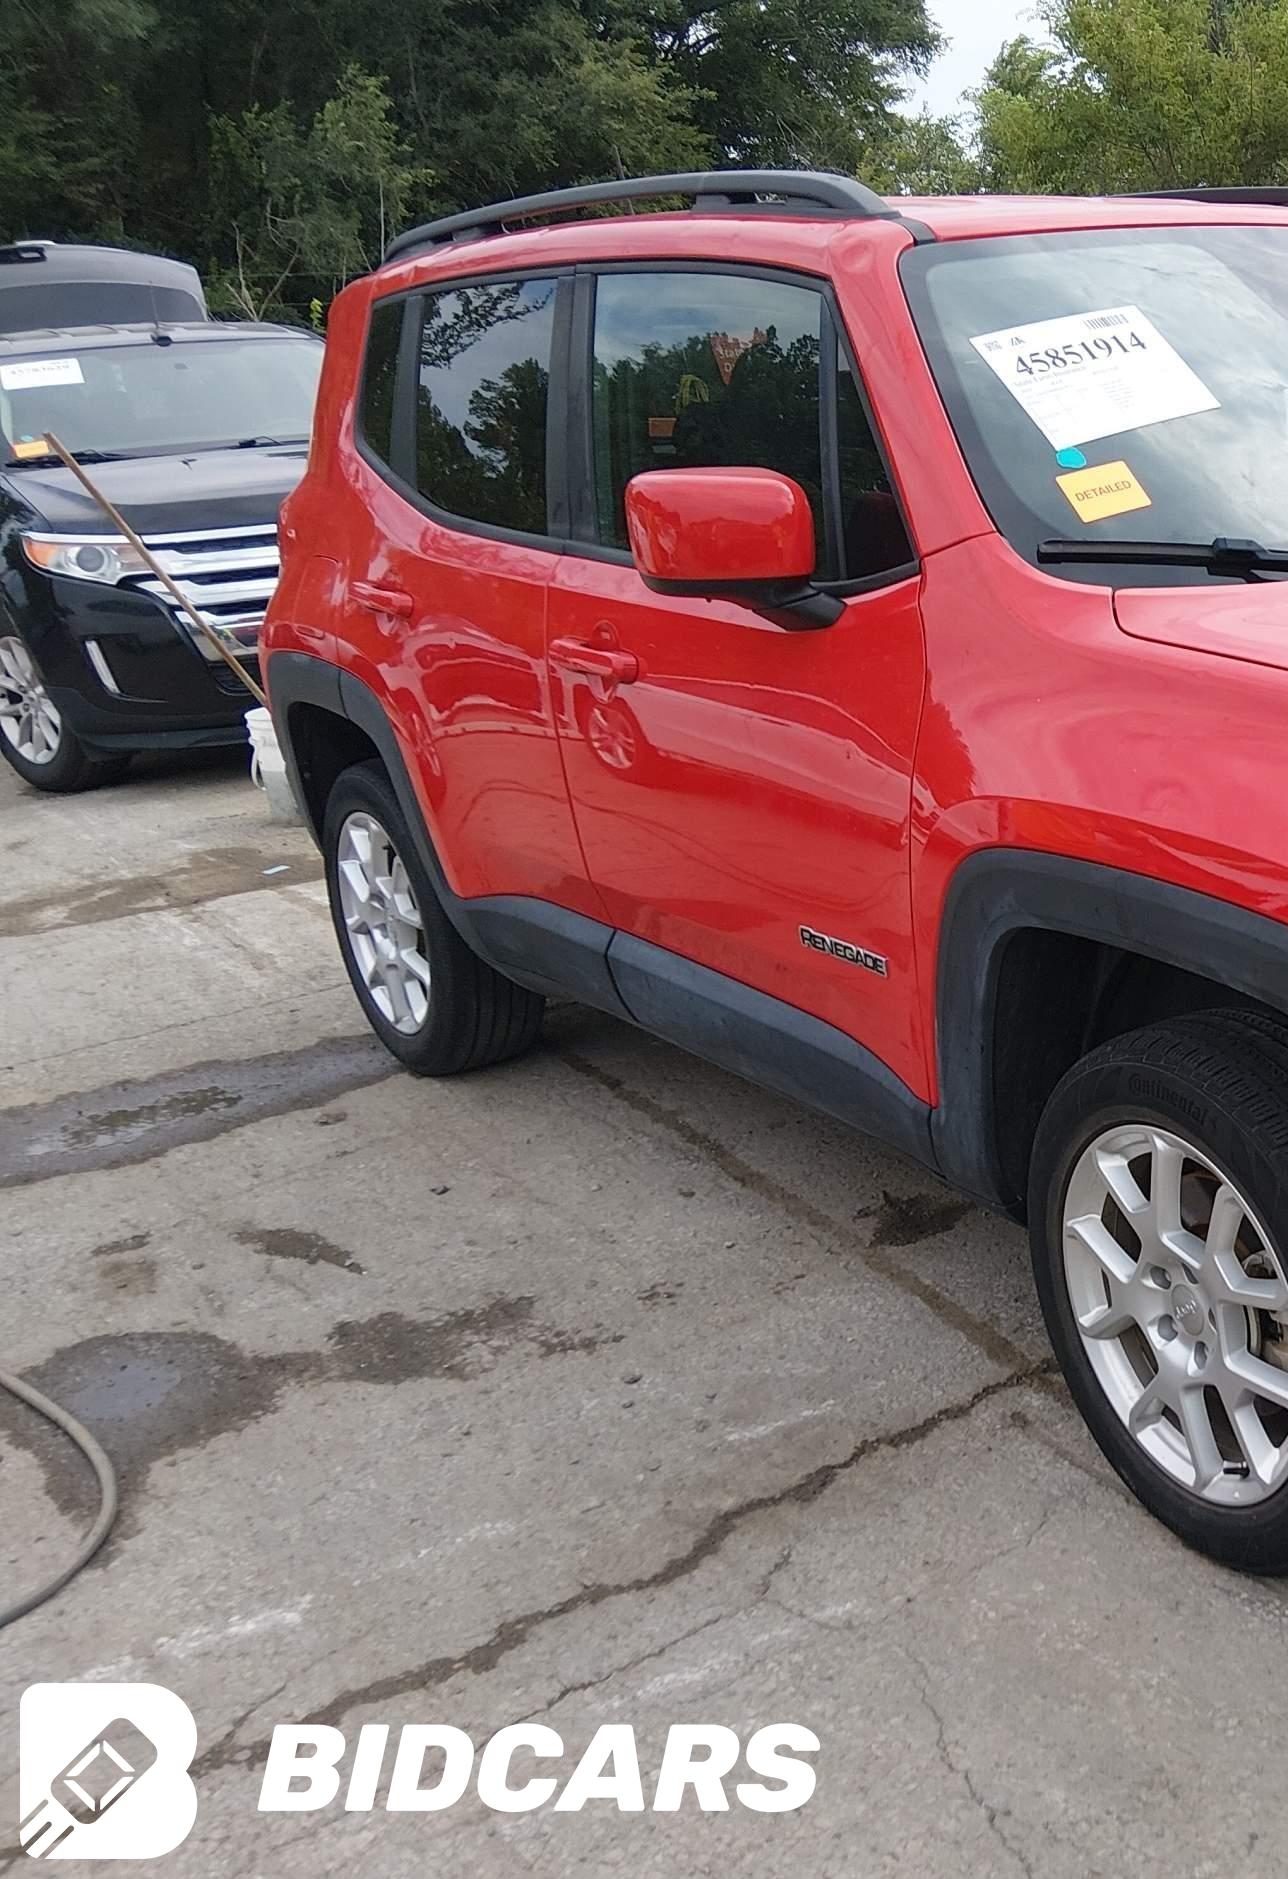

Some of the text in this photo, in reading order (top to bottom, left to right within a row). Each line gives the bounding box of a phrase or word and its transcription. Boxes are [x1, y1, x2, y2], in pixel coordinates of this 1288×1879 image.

[1015, 331, 1147, 377] 45851914
[1074, 480, 1132, 502] DETAILED
[798, 925, 888, 978] RENEGADE
